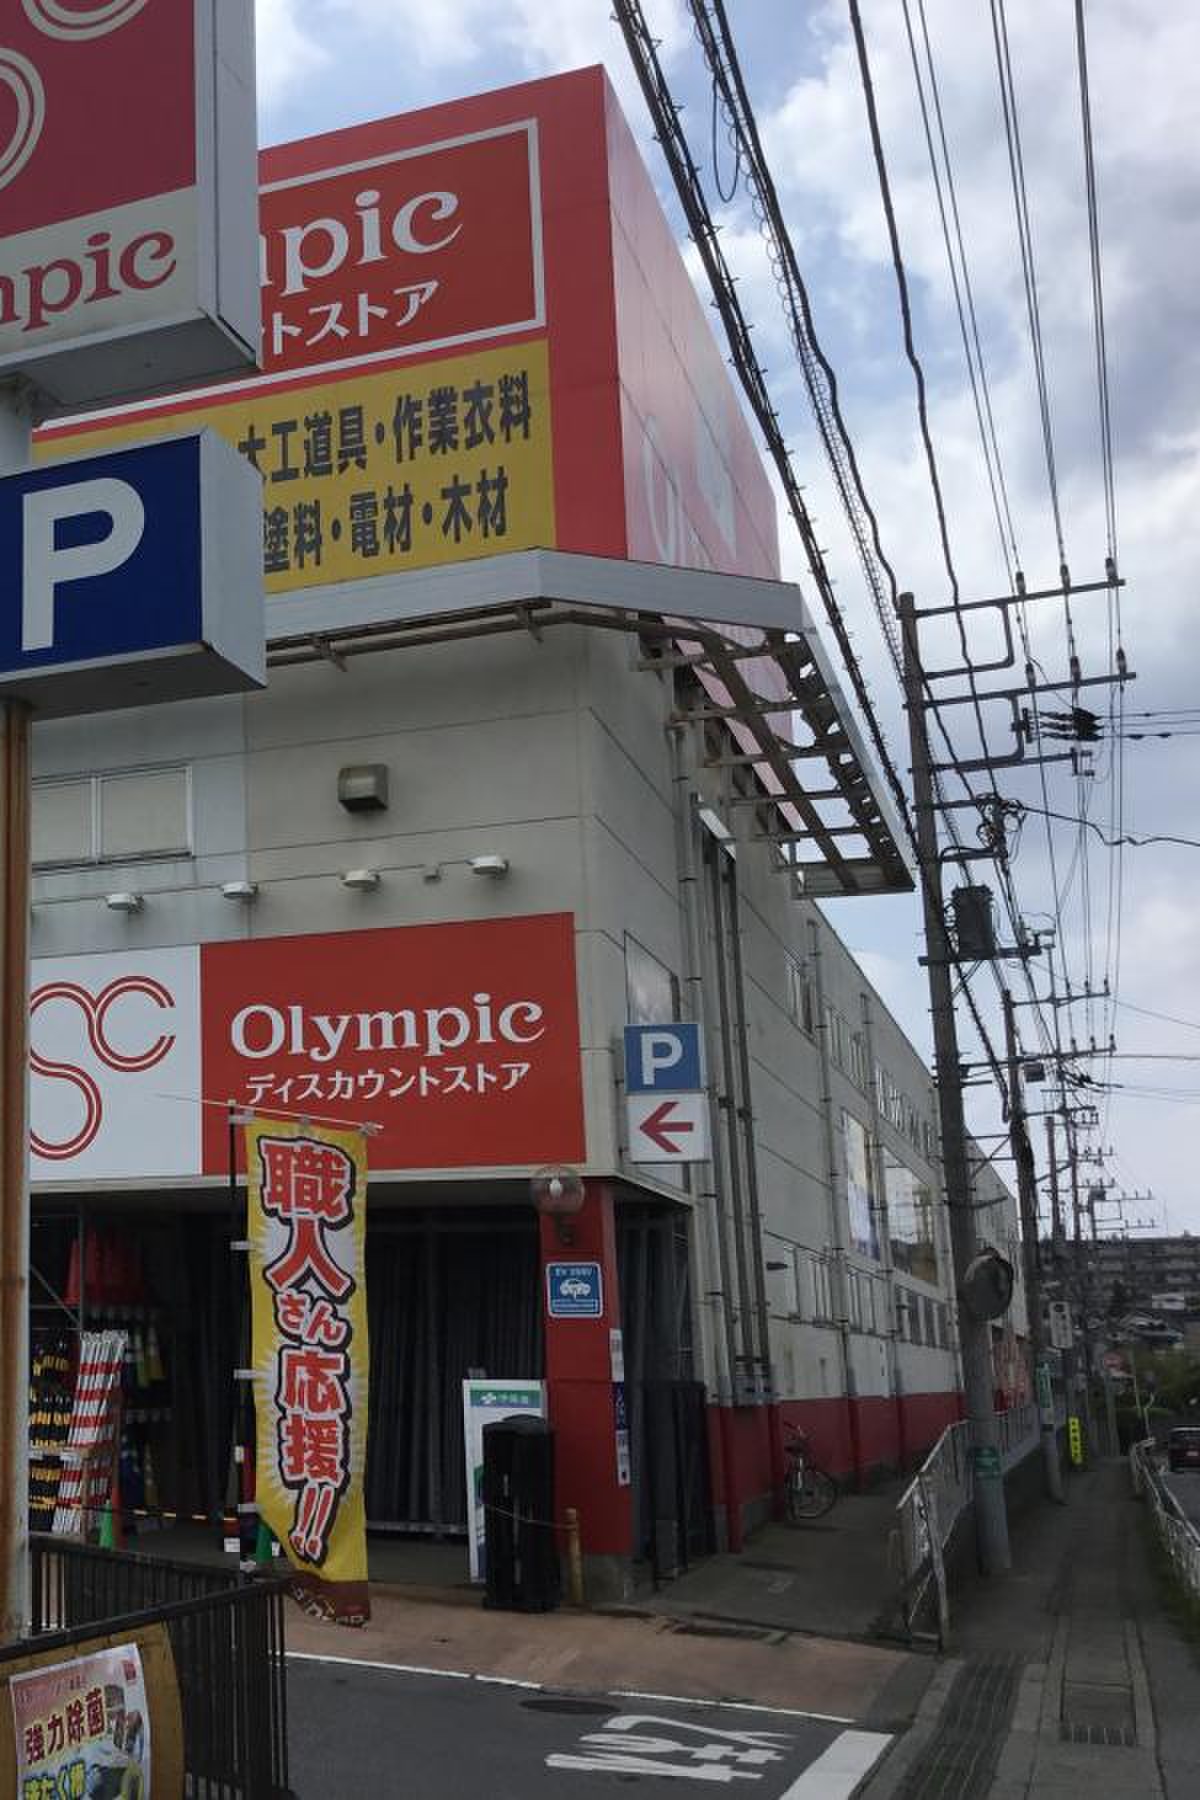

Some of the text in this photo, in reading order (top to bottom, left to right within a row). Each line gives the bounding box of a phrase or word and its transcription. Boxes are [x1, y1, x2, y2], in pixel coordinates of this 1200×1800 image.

[260, 189, 463, 298] pic
[261, 281, 440, 355] トストア
[21, 477, 145, 651] P
[230, 993, 546, 1062] Olympic
[641, 1031, 683, 1085] P
[245, 1063, 531, 1104] ディスカウントストア
